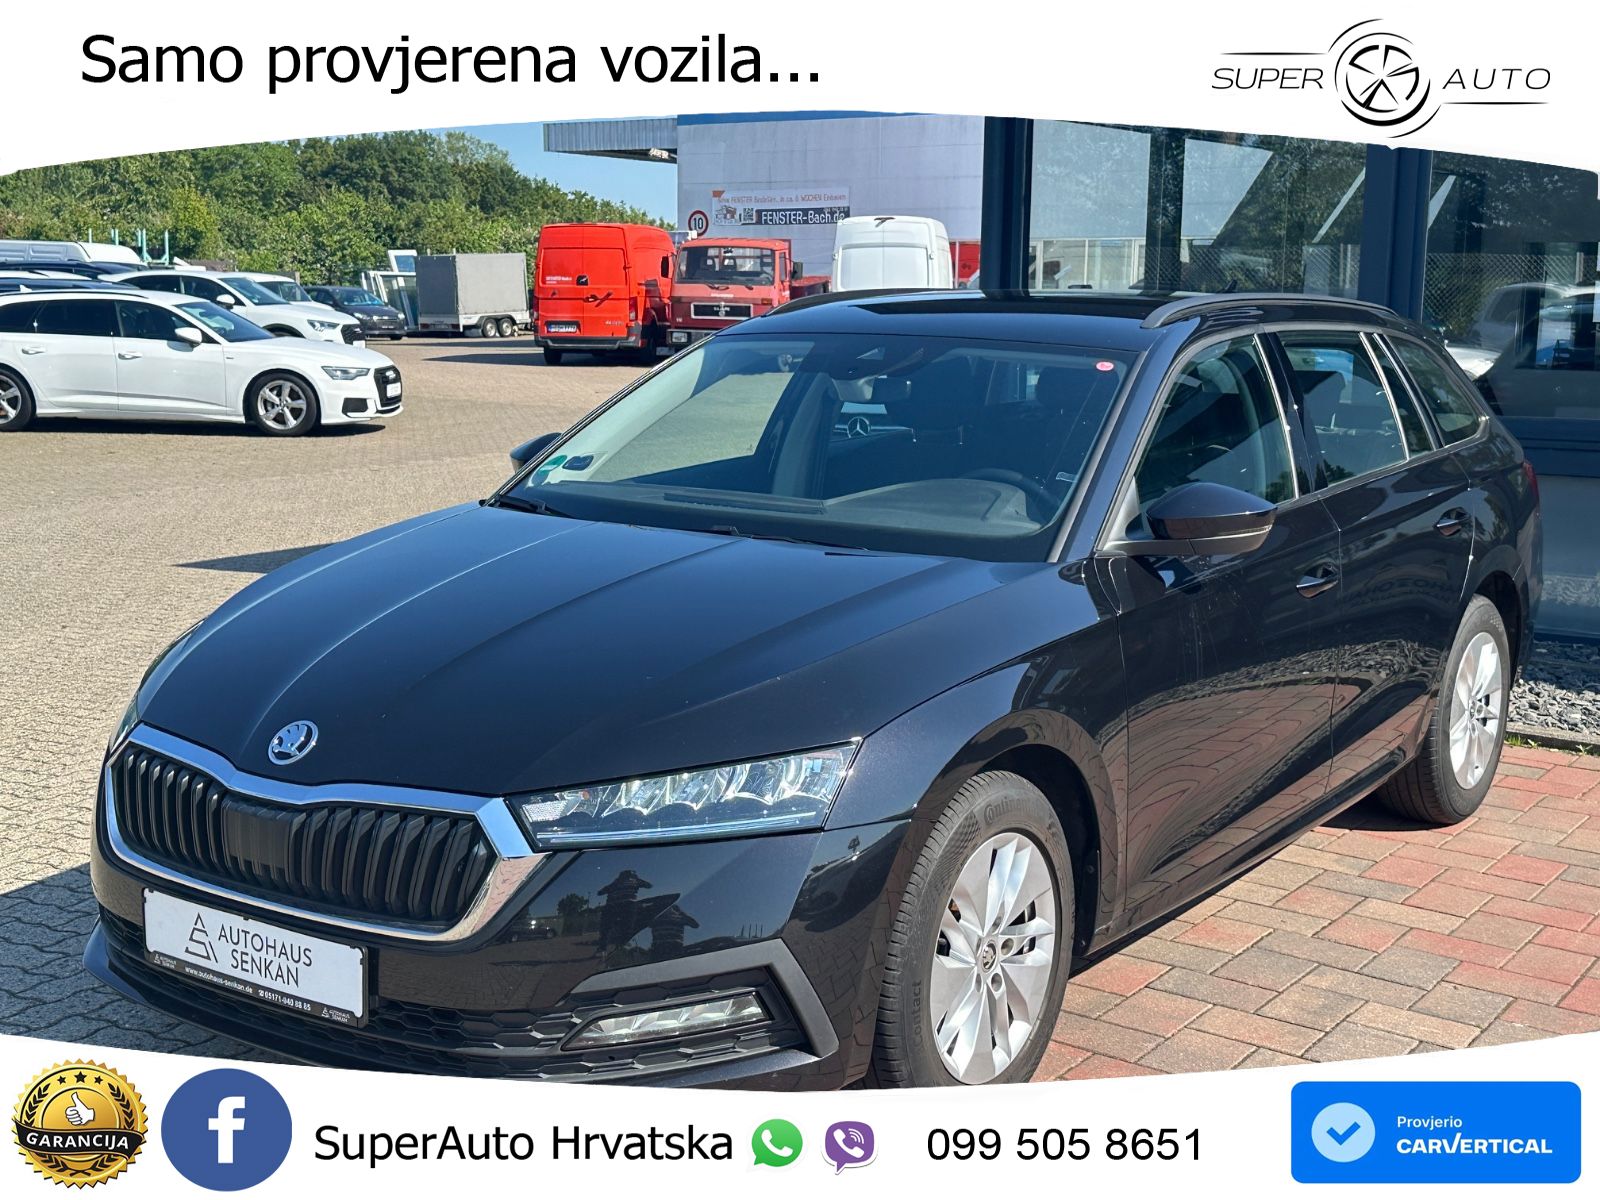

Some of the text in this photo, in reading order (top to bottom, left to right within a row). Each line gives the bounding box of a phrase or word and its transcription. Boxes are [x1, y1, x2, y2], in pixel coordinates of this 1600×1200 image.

[694, 217, 704, 230] 10
[217, 923, 313, 967] AUTOHAUS
[230, 948, 299, 988] SENKAN
